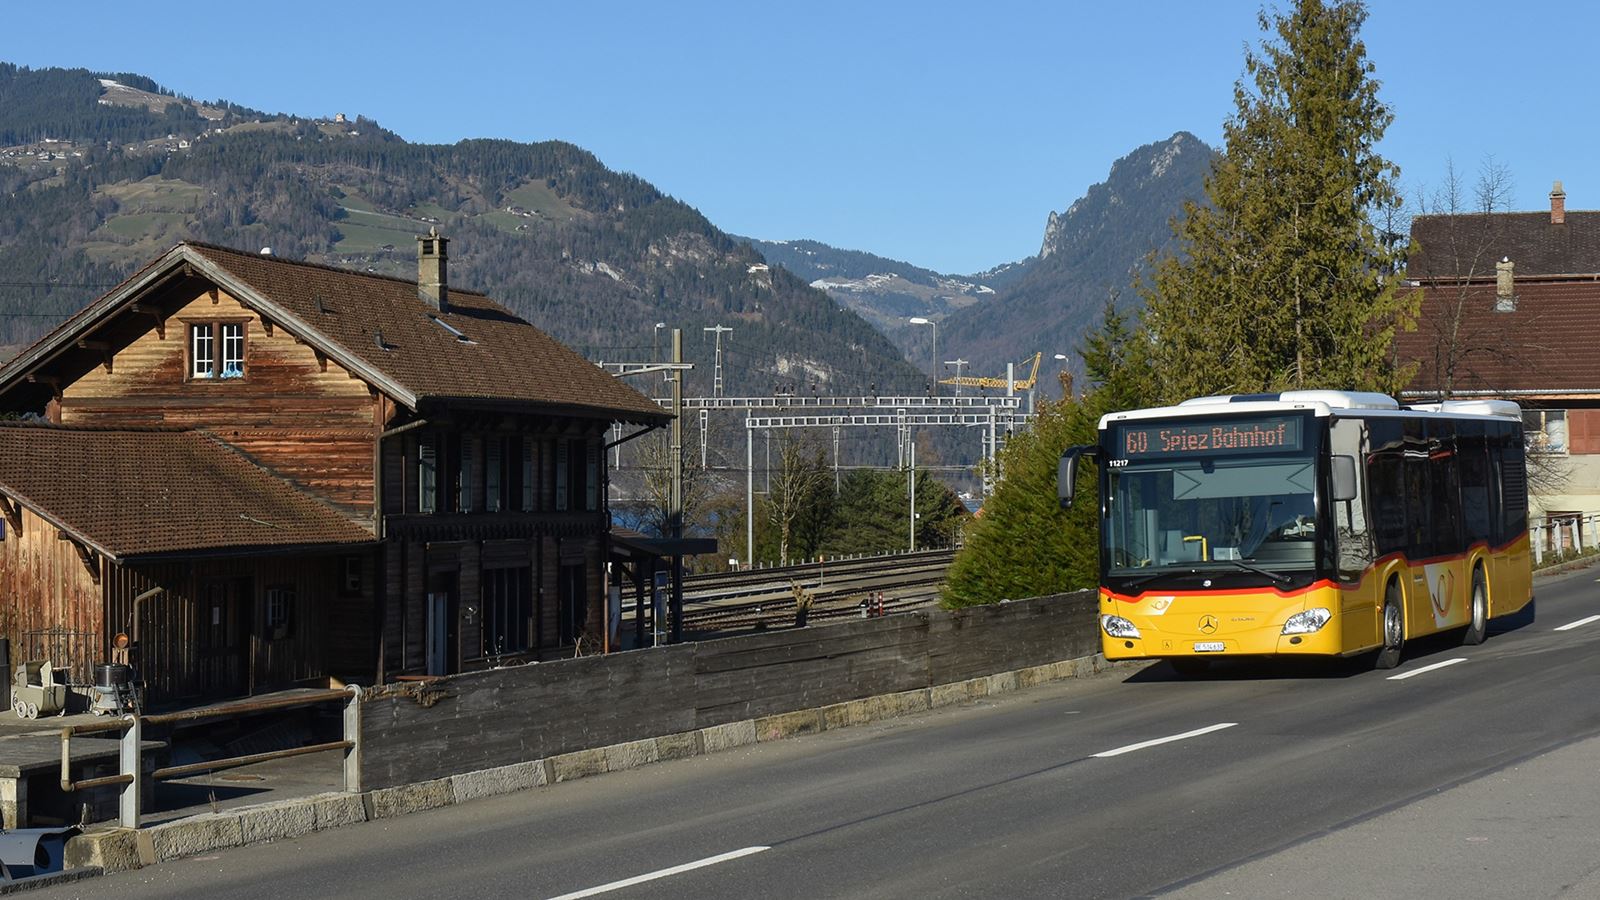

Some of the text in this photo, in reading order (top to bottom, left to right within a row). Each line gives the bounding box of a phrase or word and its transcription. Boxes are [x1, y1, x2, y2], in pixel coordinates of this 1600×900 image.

[1127, 423, 1285, 453] 60 Spiez Bahnhof
[1109, 459, 1128, 467] 11217
